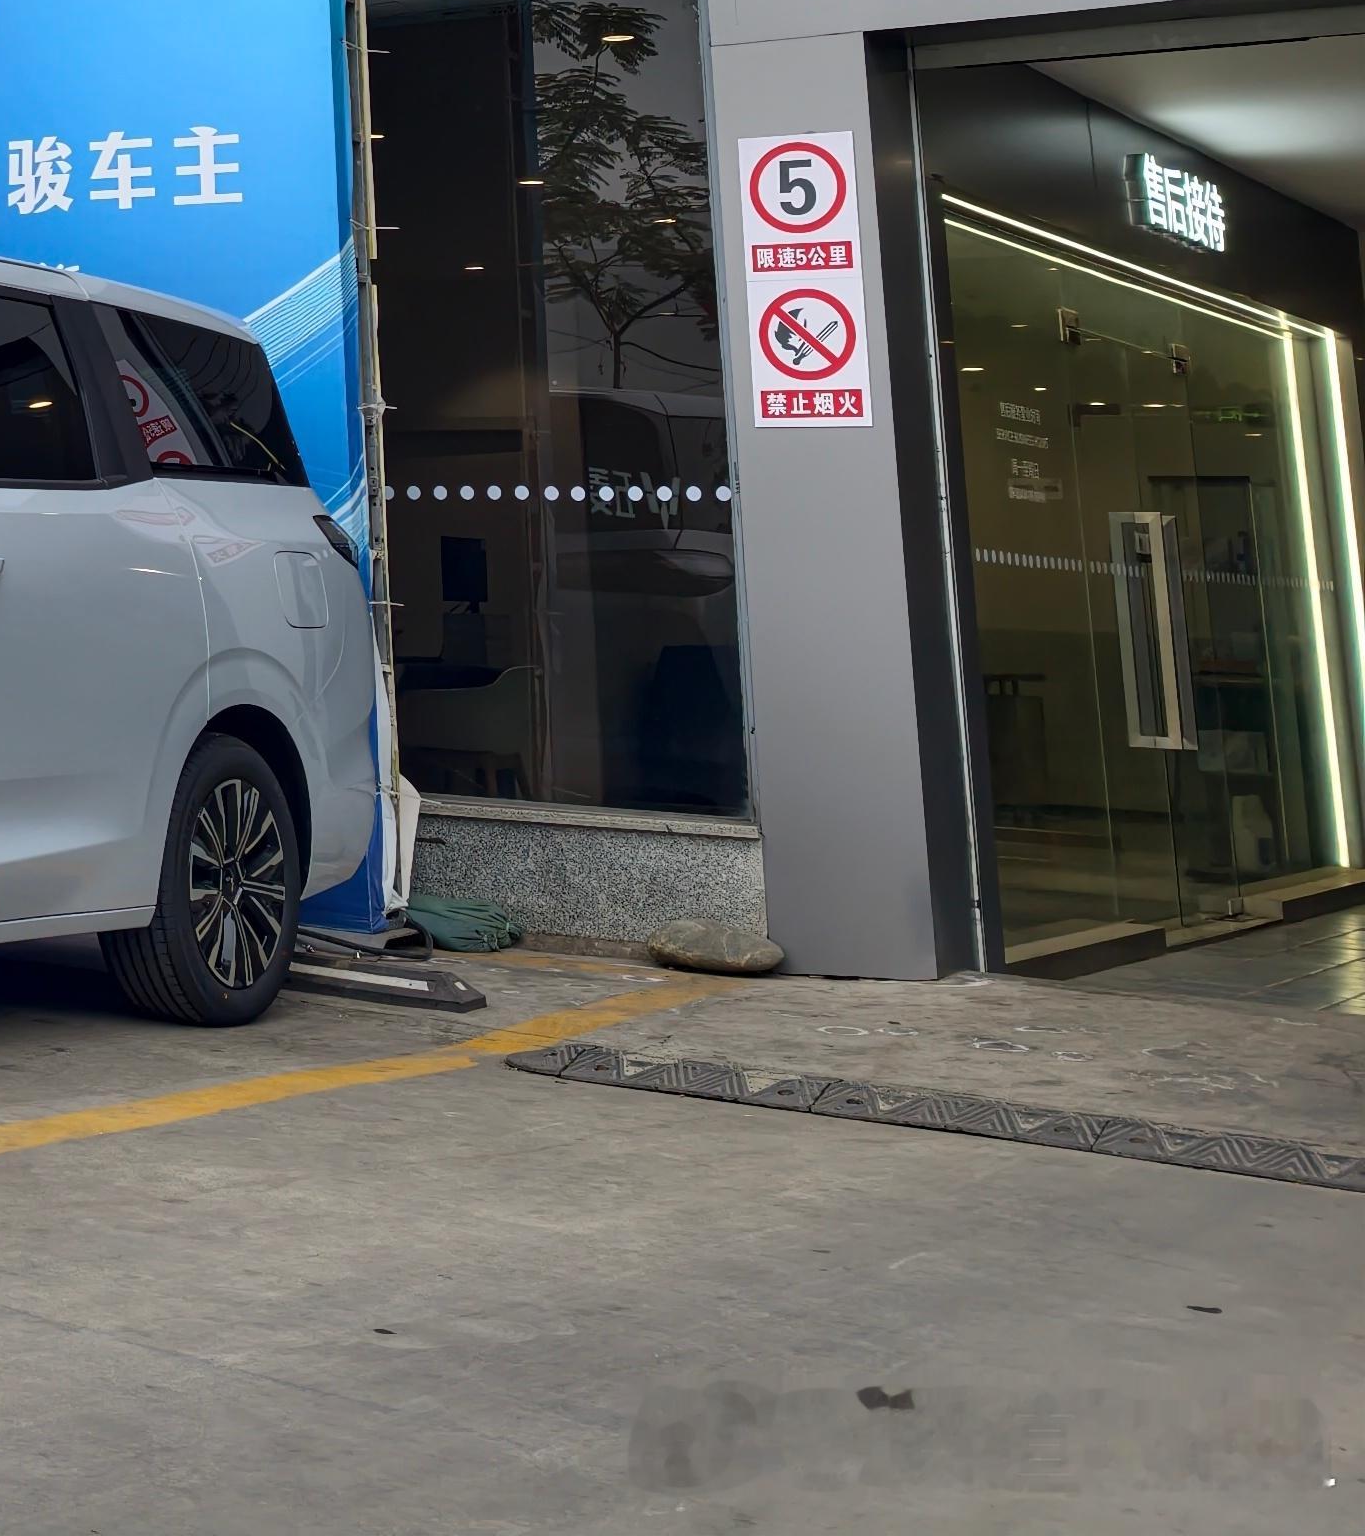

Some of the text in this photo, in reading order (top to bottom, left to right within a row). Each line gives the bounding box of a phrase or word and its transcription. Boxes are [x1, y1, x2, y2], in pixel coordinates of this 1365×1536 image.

[779, 159, 817, 216] 5
[1142, 152, 1226, 252] 售后接待
[756, 245, 849, 269] 限速5公里
[766, 392, 859, 416] 禁止烟火
